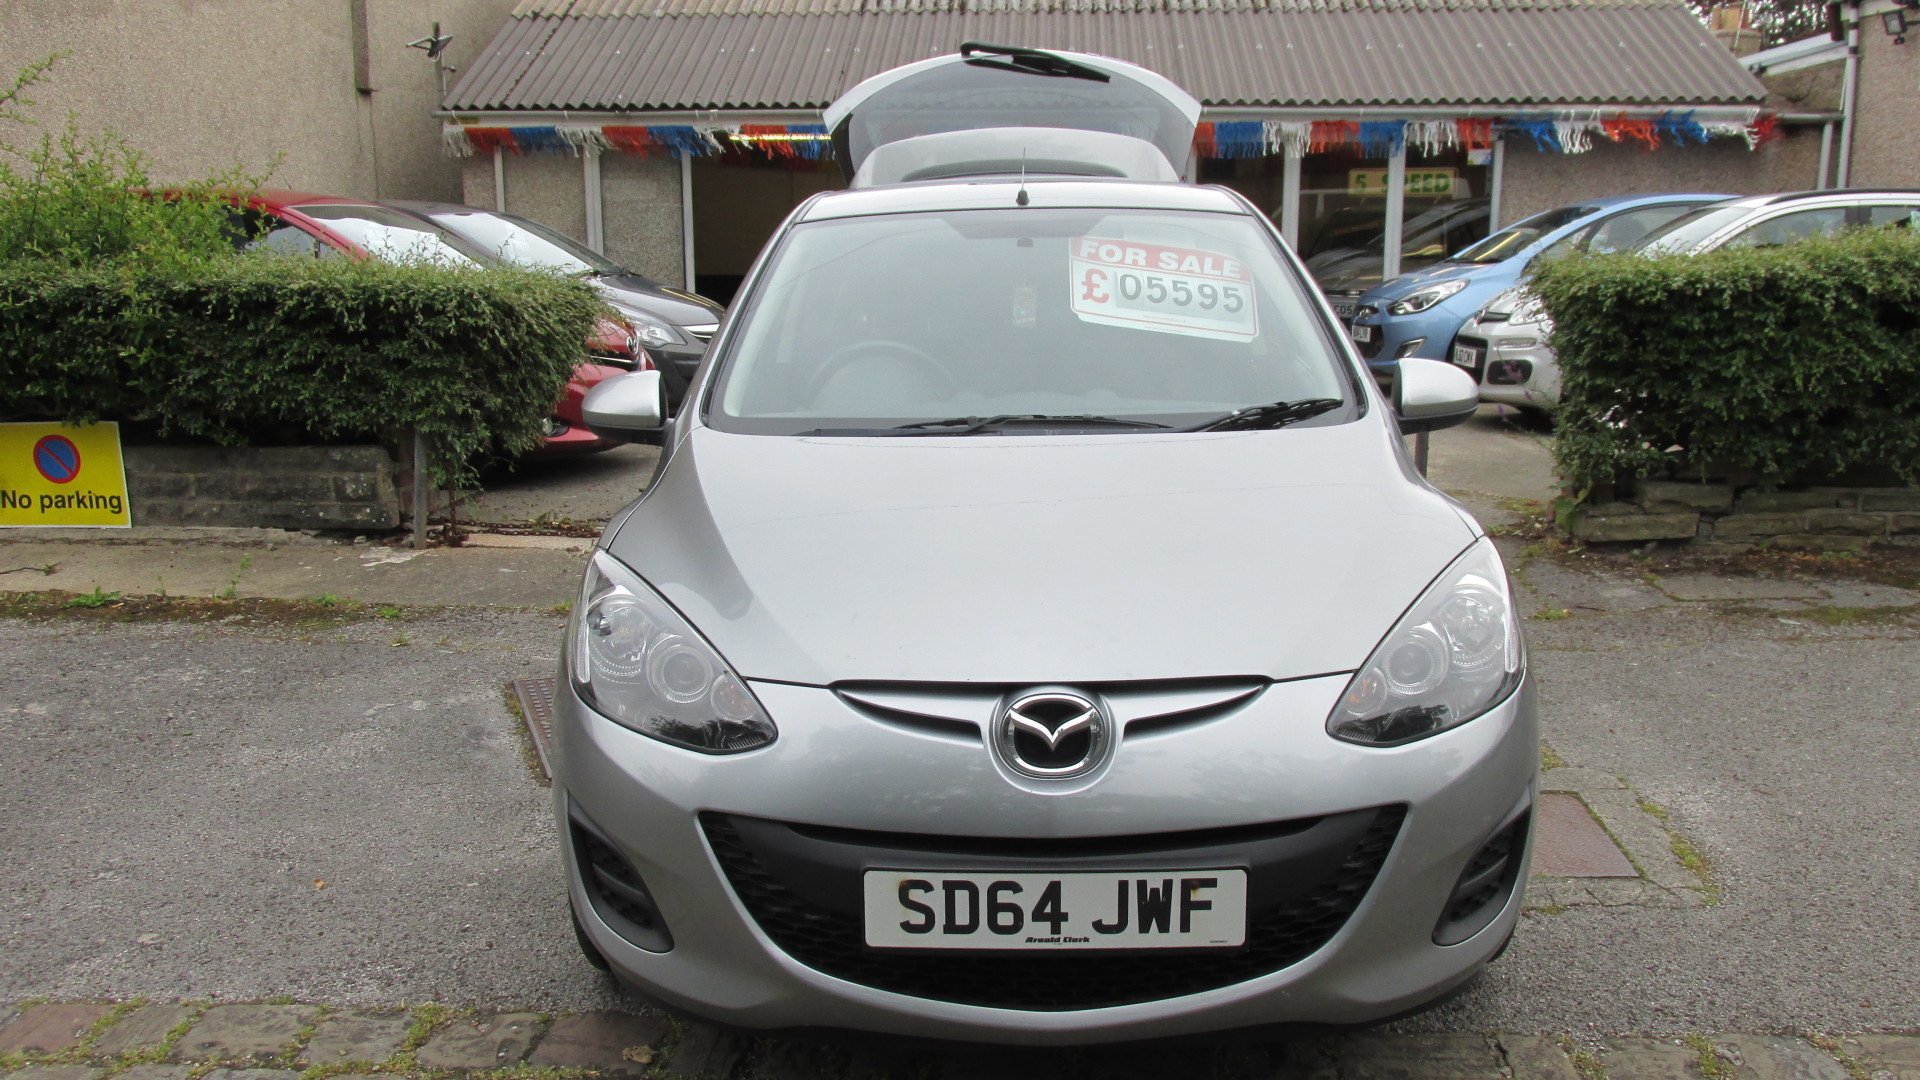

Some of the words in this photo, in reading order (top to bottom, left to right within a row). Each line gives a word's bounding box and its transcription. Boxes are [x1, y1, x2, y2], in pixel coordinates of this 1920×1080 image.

[1356, 174, 1367, 192] 5
[1080, 239, 1147, 267] FOR
[1157, 251, 1242, 279] SALE
[1, 489, 33, 510] No
[39, 490, 123, 515] parking
[897, 879, 1070, 935] SD64
[1091, 877, 1218, 934] JWF
[1025, 936, 1061, 944] Arnold
